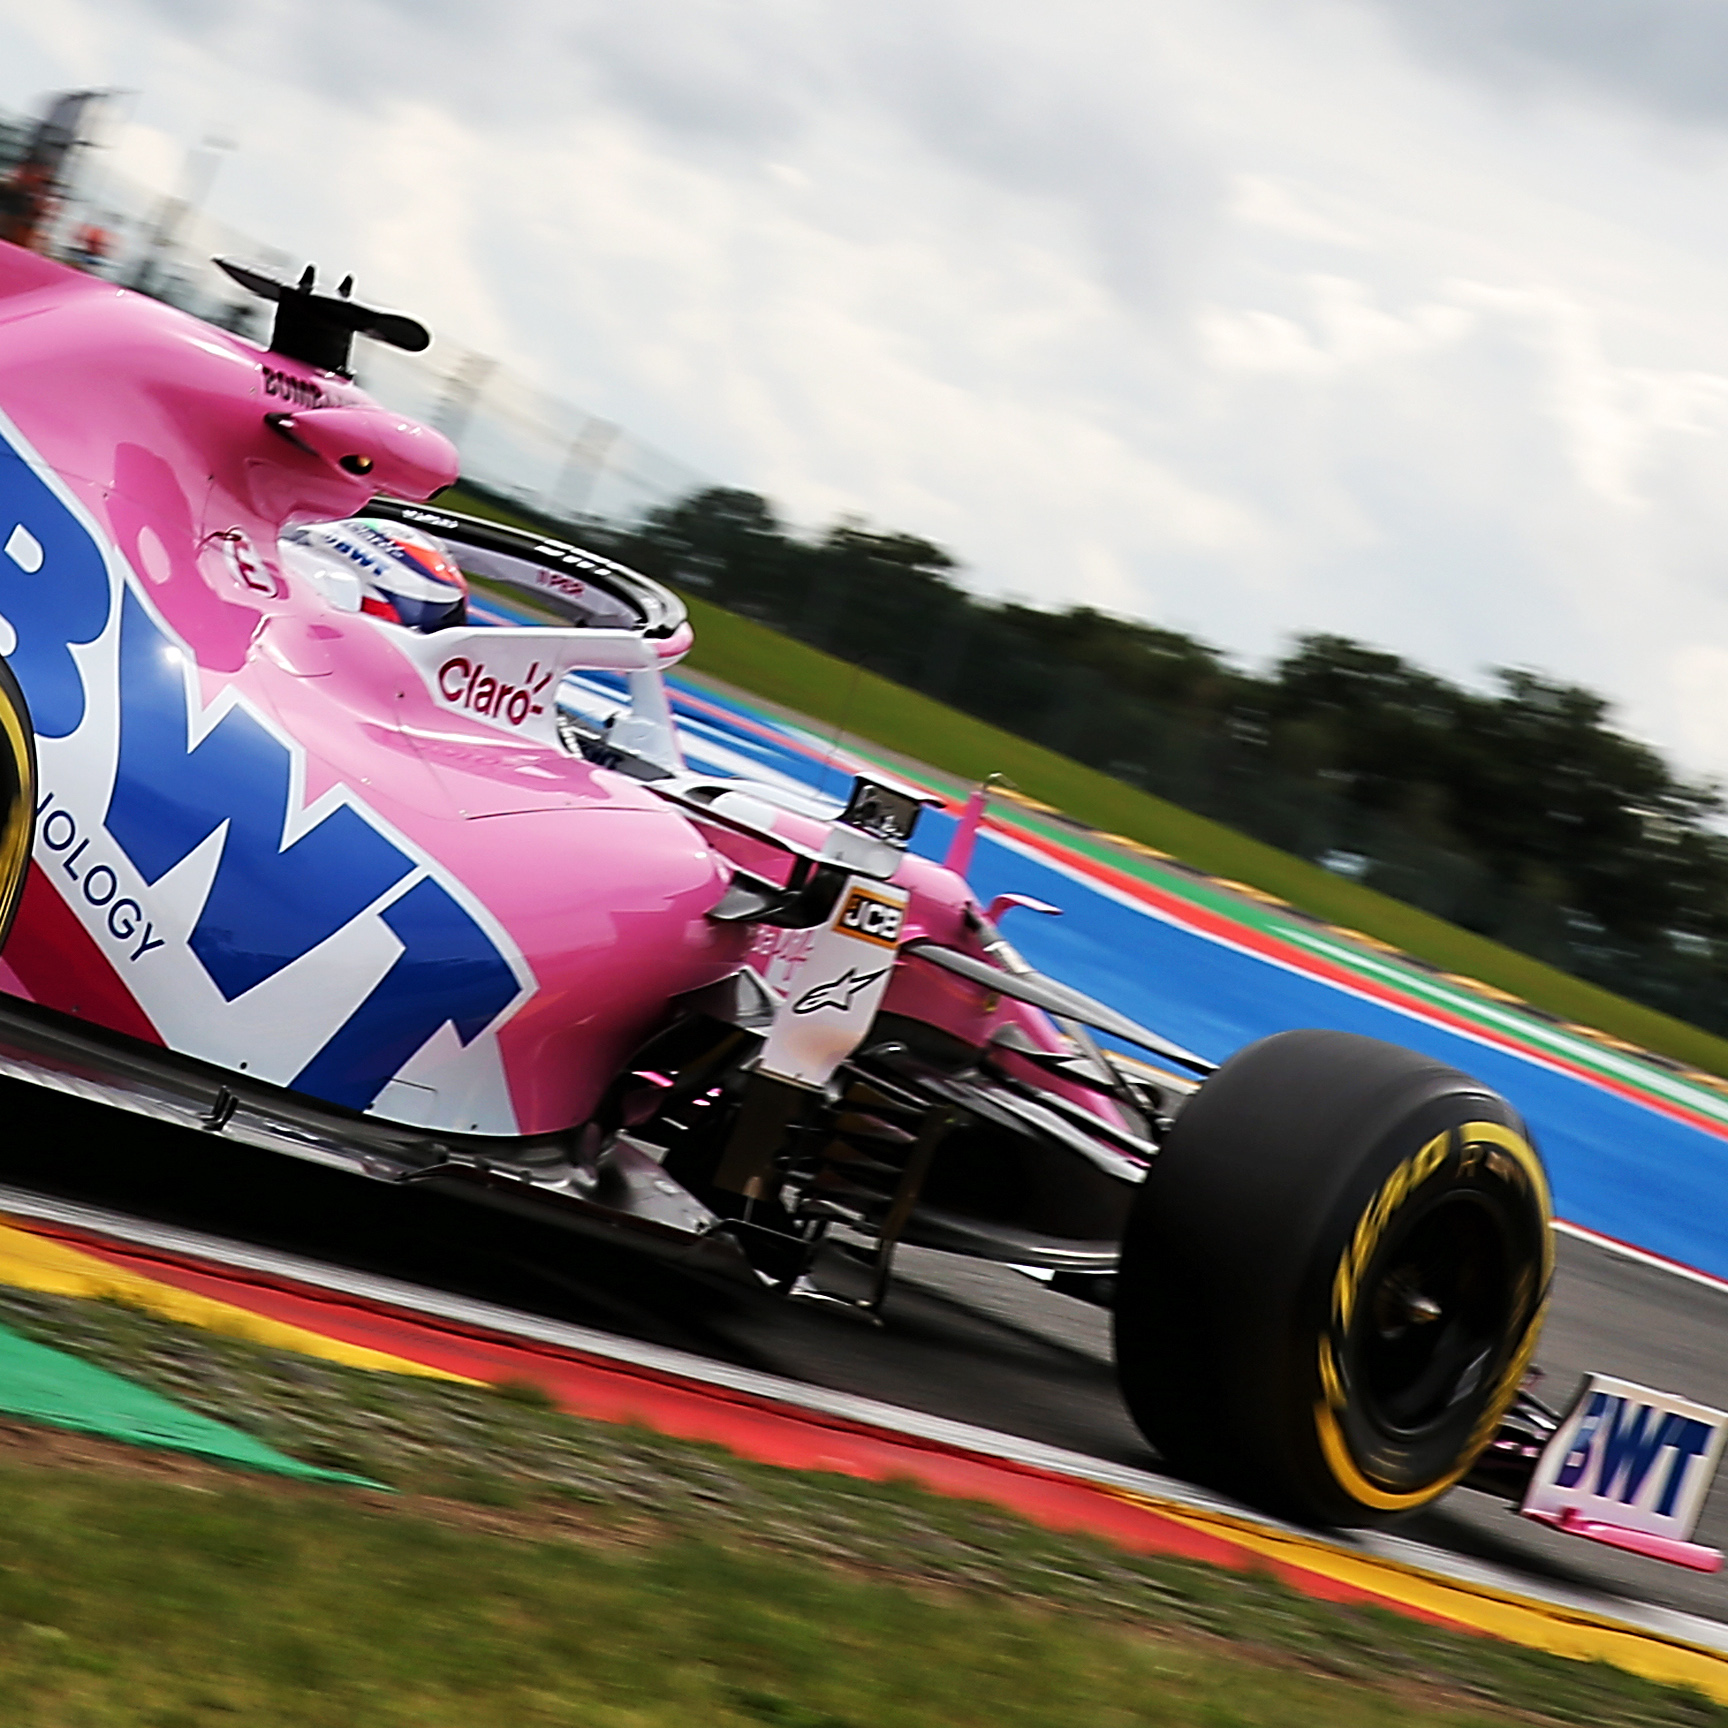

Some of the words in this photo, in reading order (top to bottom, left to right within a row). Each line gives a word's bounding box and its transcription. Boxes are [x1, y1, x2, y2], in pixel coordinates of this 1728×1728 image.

[438, 657, 533, 726] Claro
[37, 792, 165, 962] OLOGY
[844, 900, 903, 939] JCB
[1553, 1391, 1716, 1518] BWT
